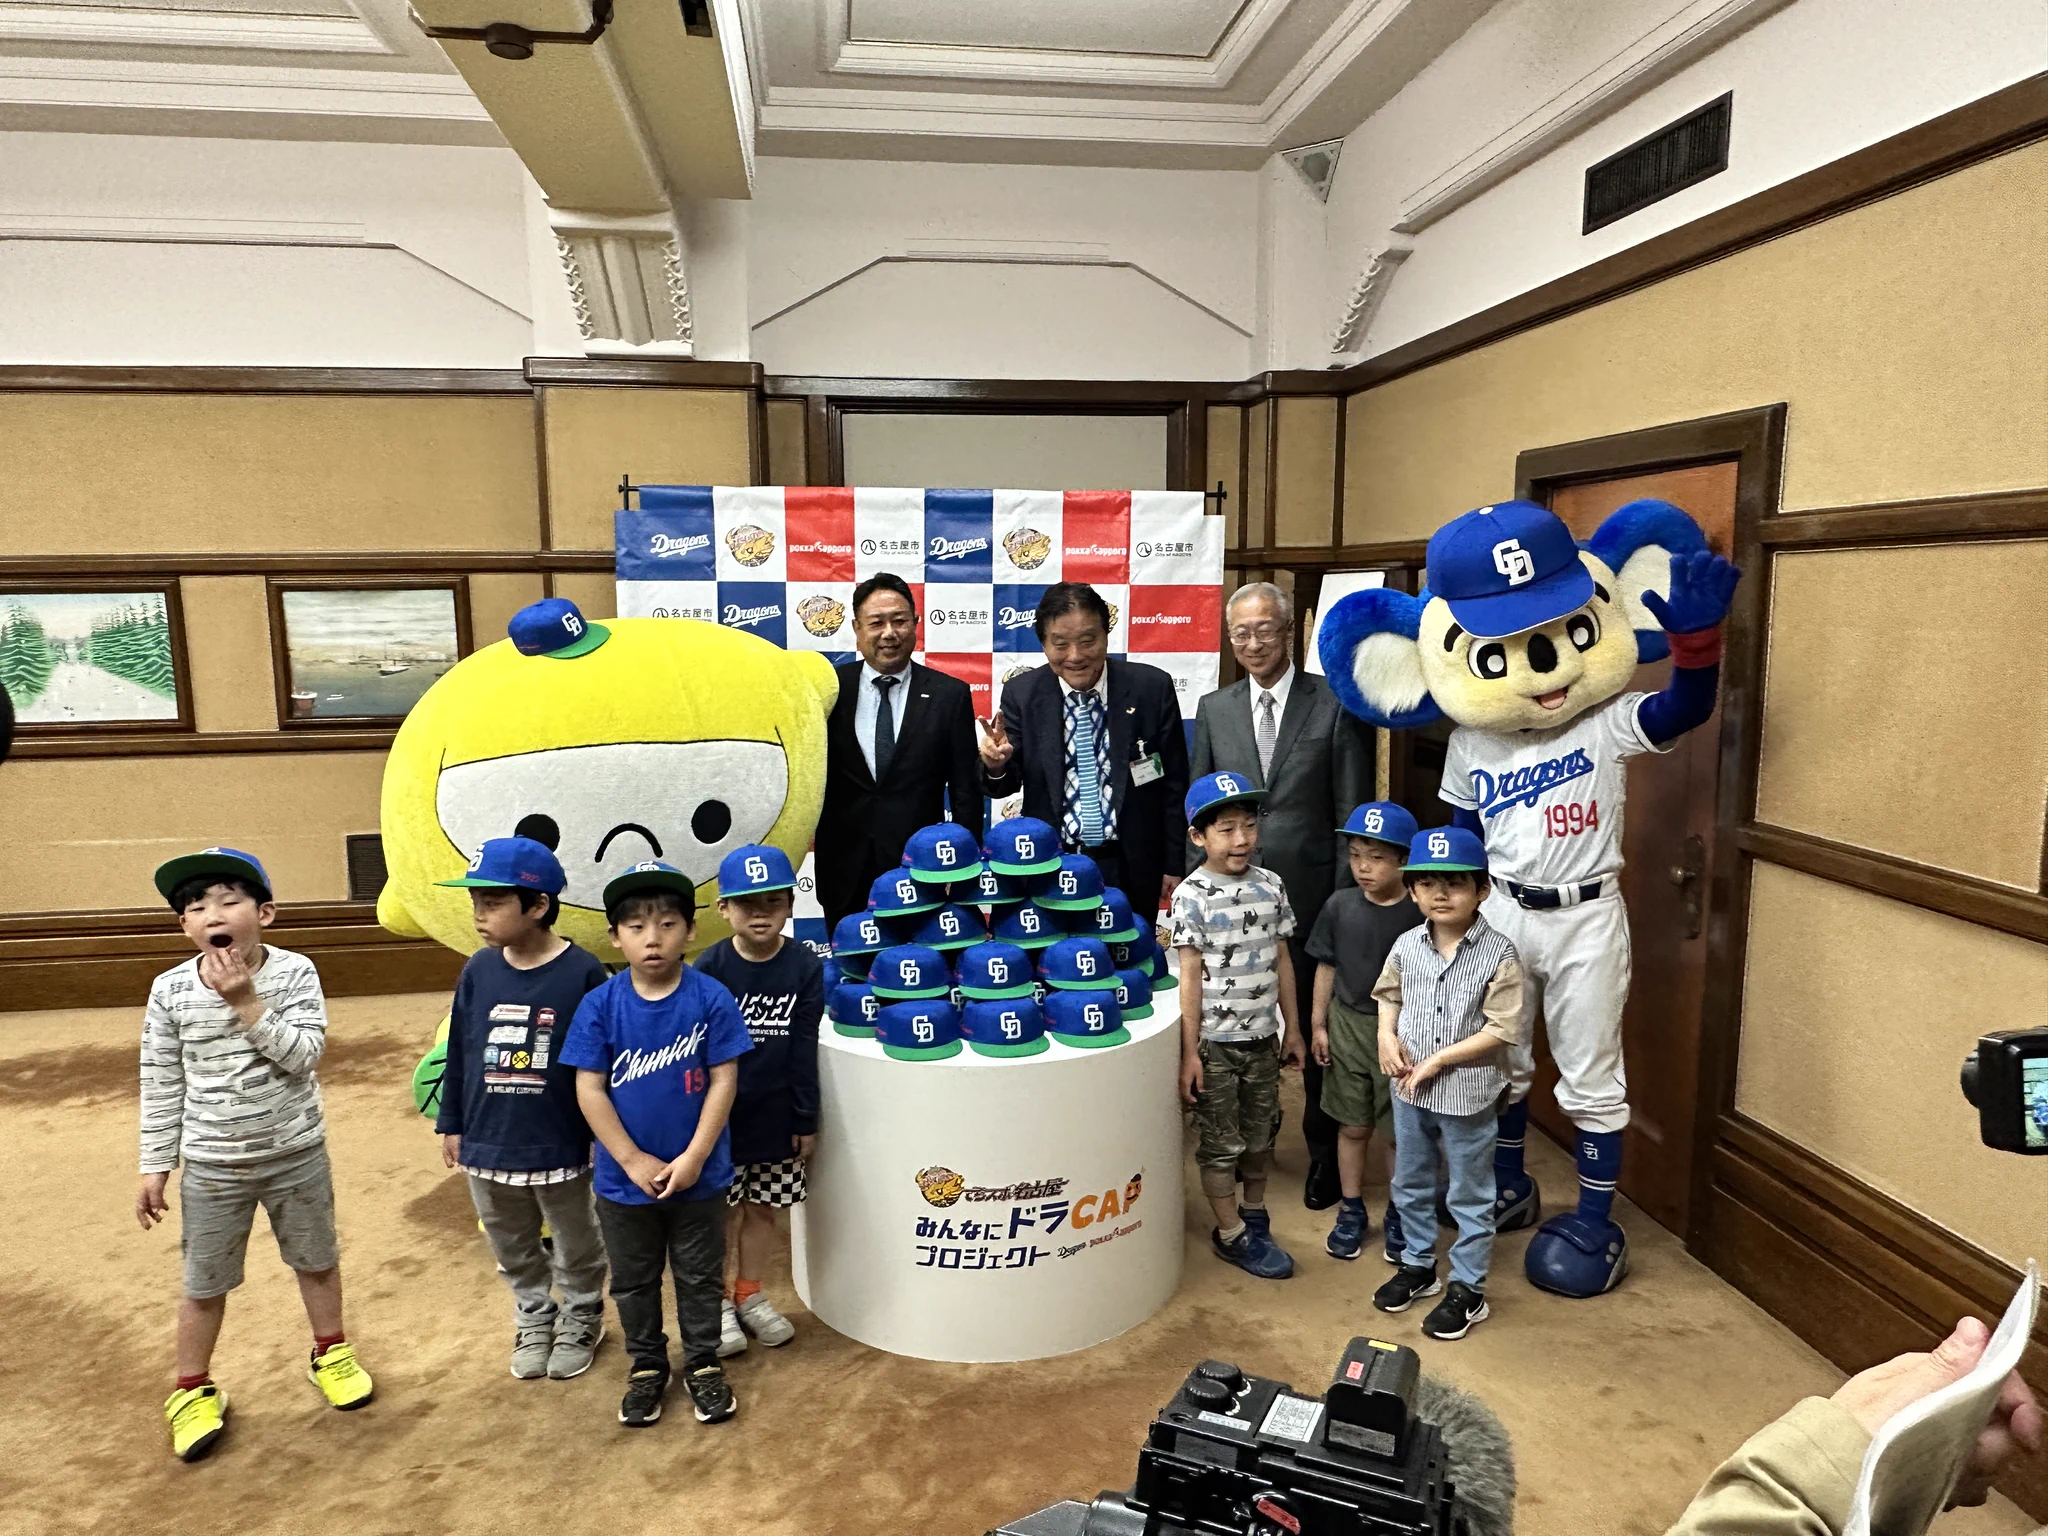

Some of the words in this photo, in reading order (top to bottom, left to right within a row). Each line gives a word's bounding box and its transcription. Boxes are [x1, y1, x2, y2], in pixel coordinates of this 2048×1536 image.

[650, 533, 710, 558] Dragons
[879, 540, 920, 550] 名古屋市
[929, 536, 988, 560] Dragons
[1154, 542, 1194, 552] 名古屋市
[670, 608, 713, 617] 名古屋市
[723, 604, 781, 627] Dragons
[948, 610, 988, 620] 名古屋市
[998, 607, 1037, 629] Drag
[1469, 747, 1594, 819] Dragons
[1544, 800, 1598, 838] 1994
[916, 1245, 1051, 1269] プロジェクト
